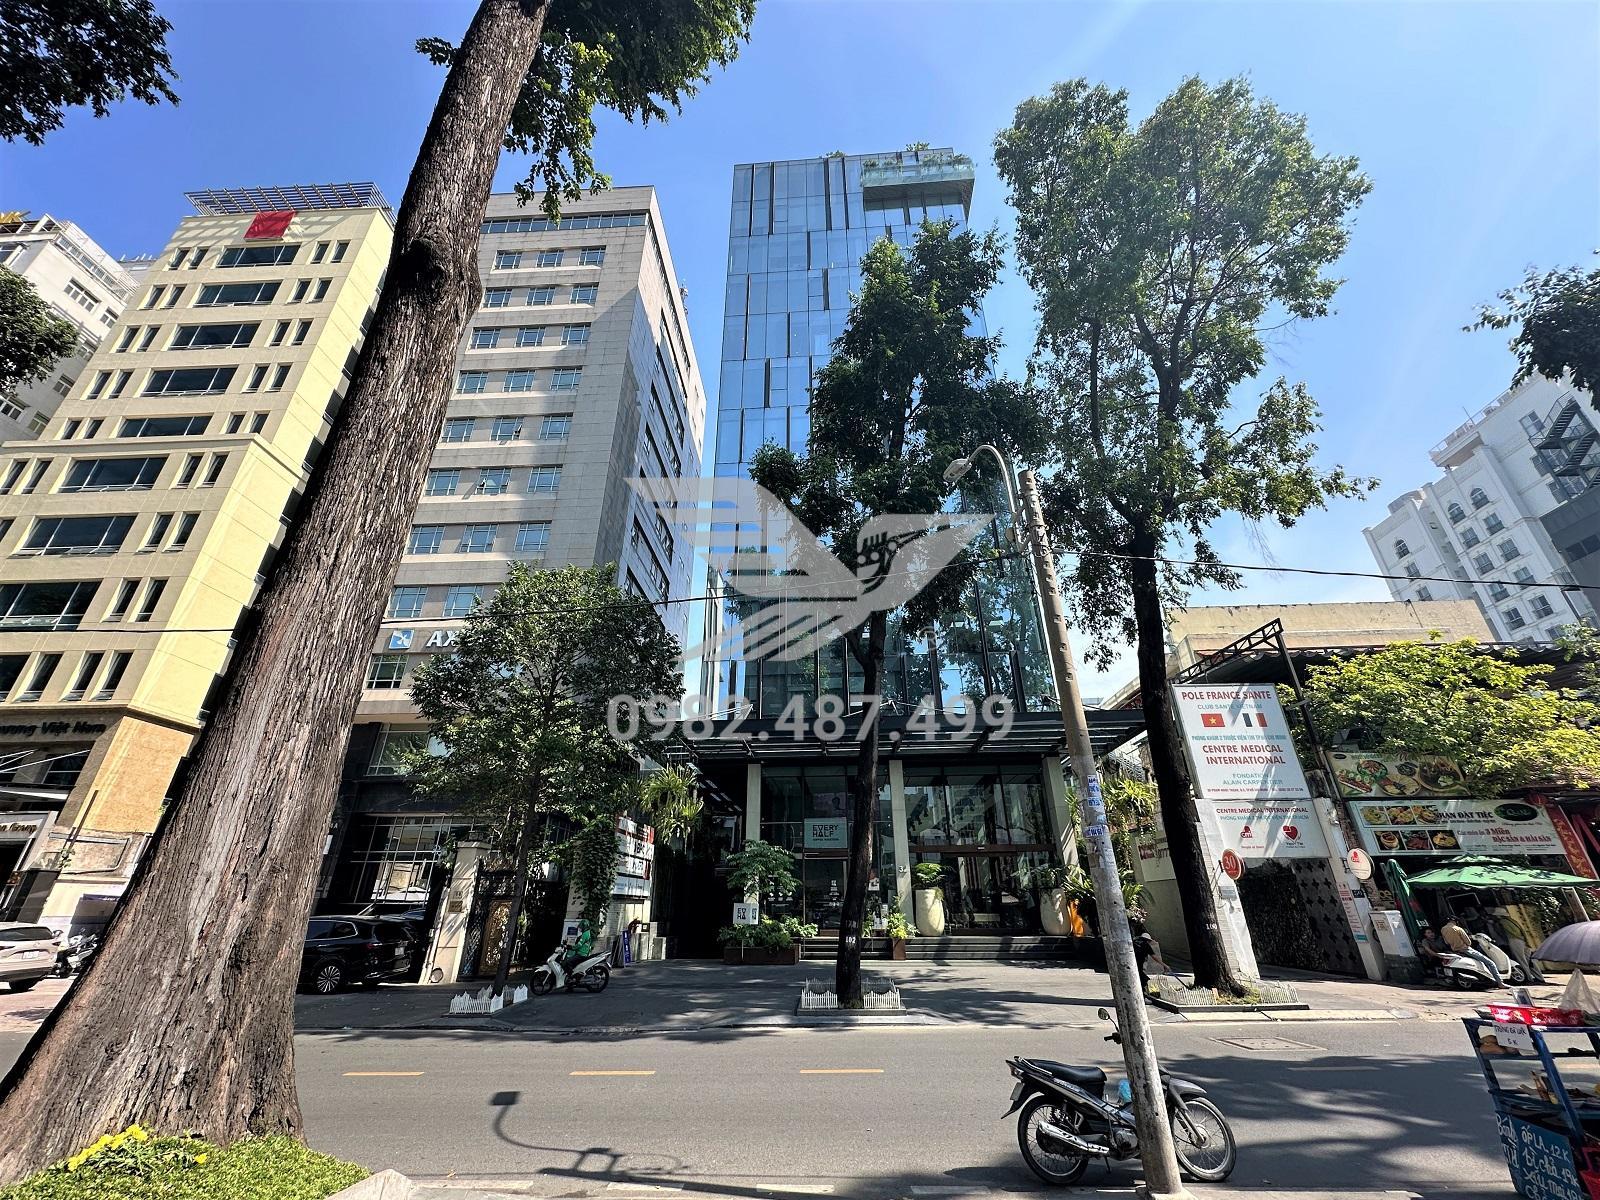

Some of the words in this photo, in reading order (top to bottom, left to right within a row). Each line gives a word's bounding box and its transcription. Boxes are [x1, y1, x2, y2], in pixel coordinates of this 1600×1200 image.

[1181, 691, 1205, 700] POLE
[1206, 691, 1240, 700] FRANCE
[1243, 690, 1272, 699] SANTE
[1202, 745, 1238, 753] CENTRE
[1241, 744, 1283, 753] MEDICAL
[1206, 756, 1286, 765] INTERNATIONAL
[812, 830, 834, 838] HALF
[1224, 856, 1237, 870] 30
